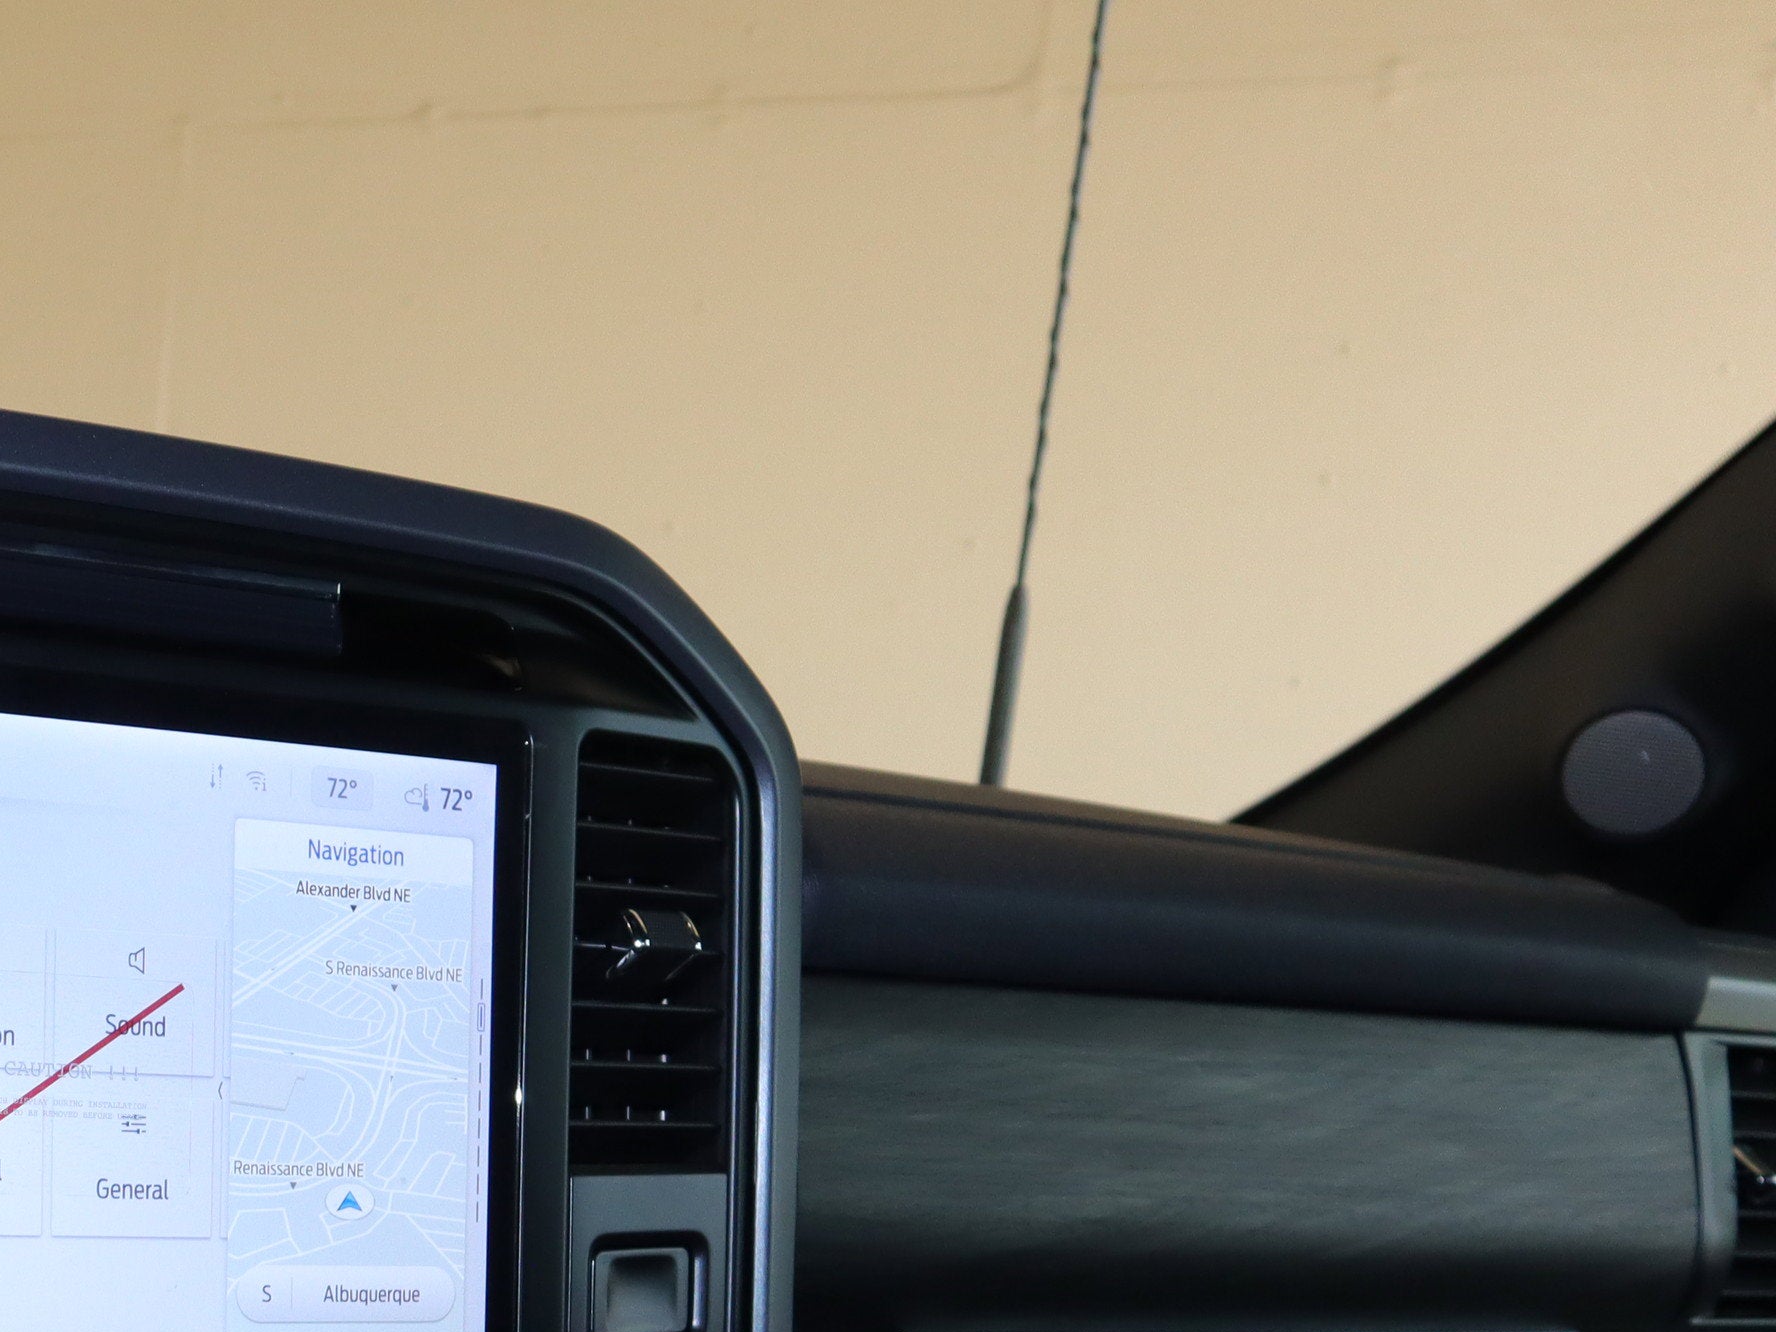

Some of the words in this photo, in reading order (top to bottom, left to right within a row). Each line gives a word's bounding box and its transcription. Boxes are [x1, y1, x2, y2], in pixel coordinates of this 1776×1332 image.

[327, 778, 358, 800] 72°
[440, 787, 473, 811] 72°
[308, 839, 405, 867] Navigation
[296, 880, 361, 900] Alexander
[363, 885, 392, 902] Blvd
[394, 887, 411, 903] NE
[325, 960, 334, 976] S
[337, 963, 414, 981] Renaissance
[416, 965, 445, 982] Blvd
[447, 968, 463, 983] NE
[105, 1013, 166, 1038] Sound
[4, 1061, 92, 1079] CAUTION
[233, 1160, 313, 1178] Renaissance
[316, 1161, 345, 1178] Blvd
[347, 1162, 365, 1178] NE
[96, 1179, 169, 1201] General
[262, 1285, 272, 1303] S
[323, 1284, 421, 1306] Albuquerque
